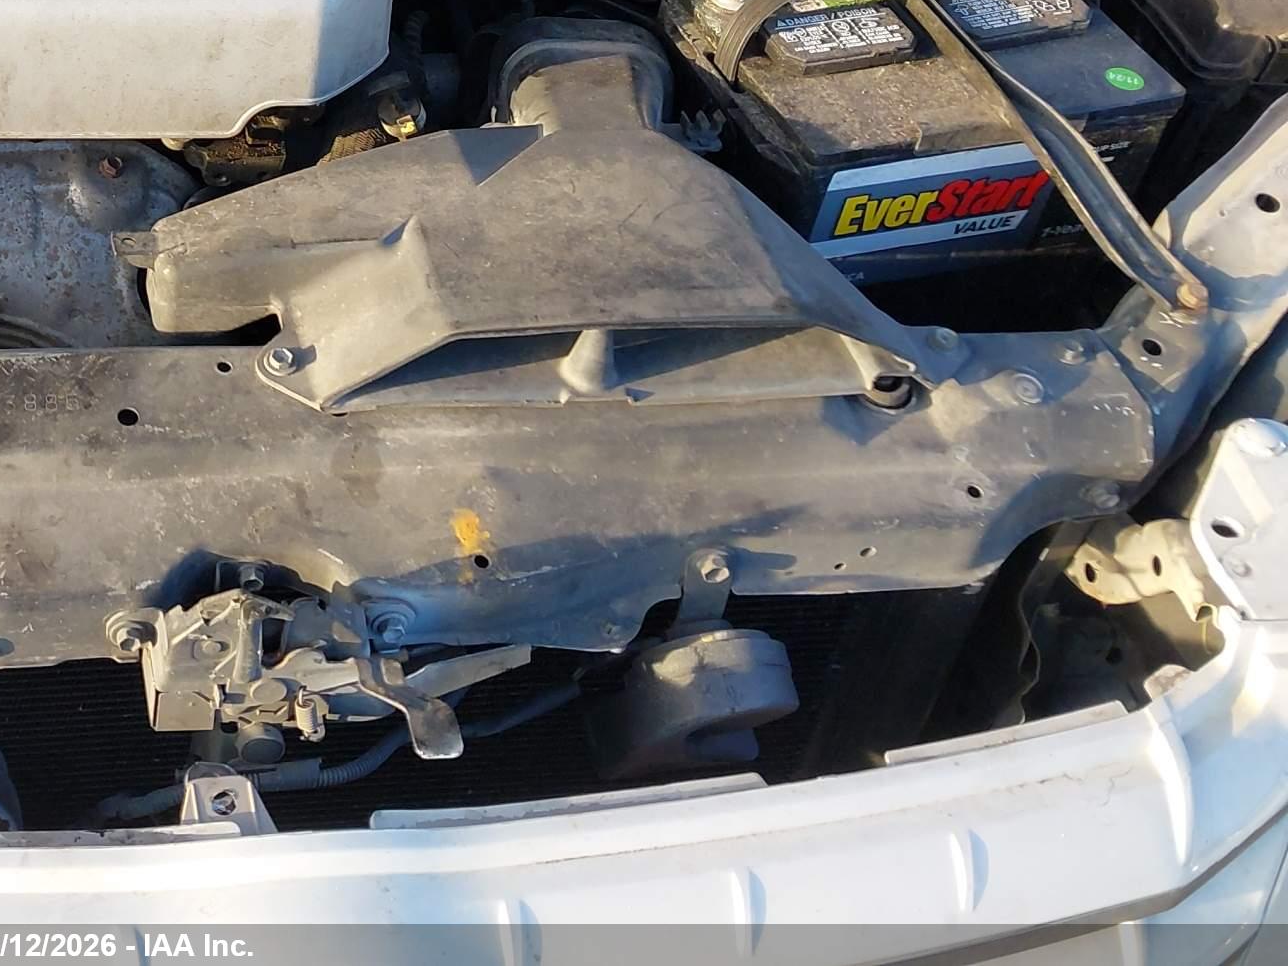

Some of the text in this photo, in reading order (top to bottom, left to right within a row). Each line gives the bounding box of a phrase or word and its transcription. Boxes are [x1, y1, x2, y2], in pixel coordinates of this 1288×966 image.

[785, 14, 829, 26] DANGER
[837, 7, 877, 19] POISON
[832, 170, 1052, 237] EverStart
[952, 214, 1016, 235] VALUE
